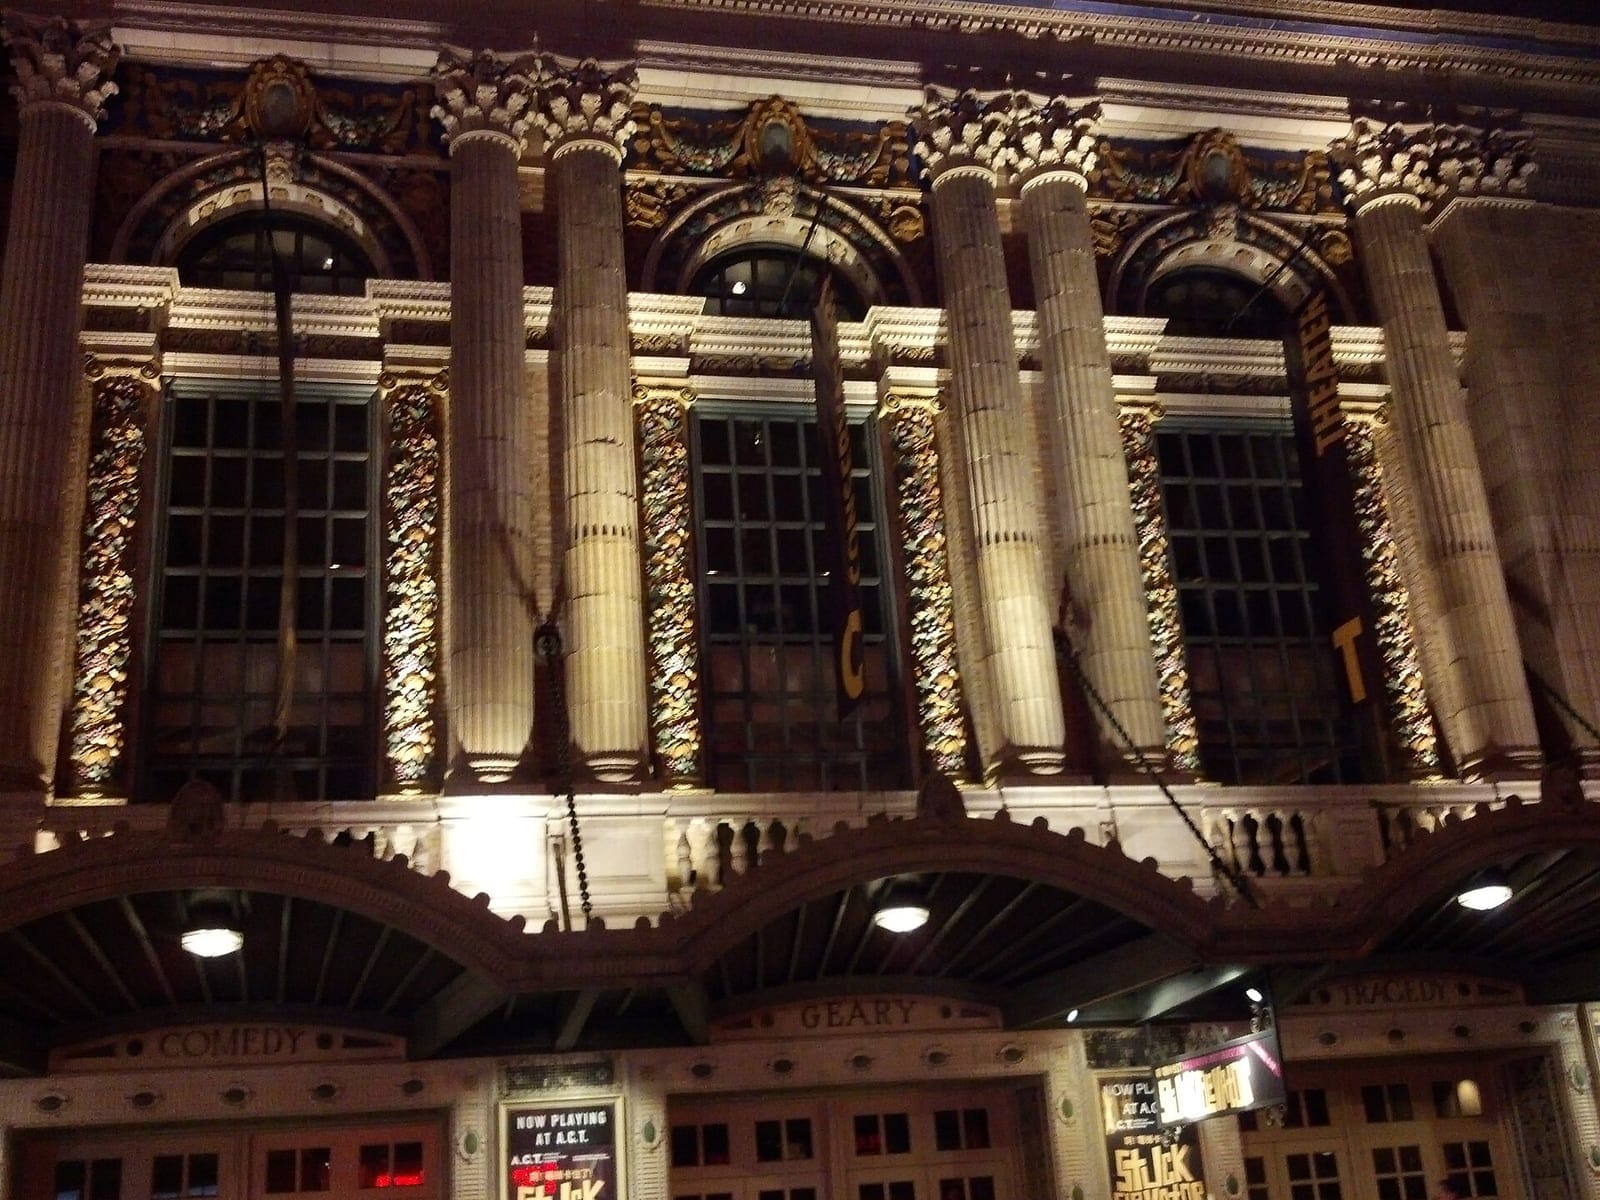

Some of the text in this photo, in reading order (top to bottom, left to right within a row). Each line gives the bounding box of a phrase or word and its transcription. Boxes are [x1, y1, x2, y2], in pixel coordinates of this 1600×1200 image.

[1299, 288, 1350, 457] THEATER
[1333, 616, 1366, 703] T
[1341, 979, 1447, 1005] TRAGEDY
[801, 1001, 917, 1029] GEARY
[159, 1027, 304, 1058] COMEDY
[516, 1110, 607, 1129] NOW PLAYING
[1122, 1102, 1139, 1115] AT
[535, 1131, 552, 1146] AT
